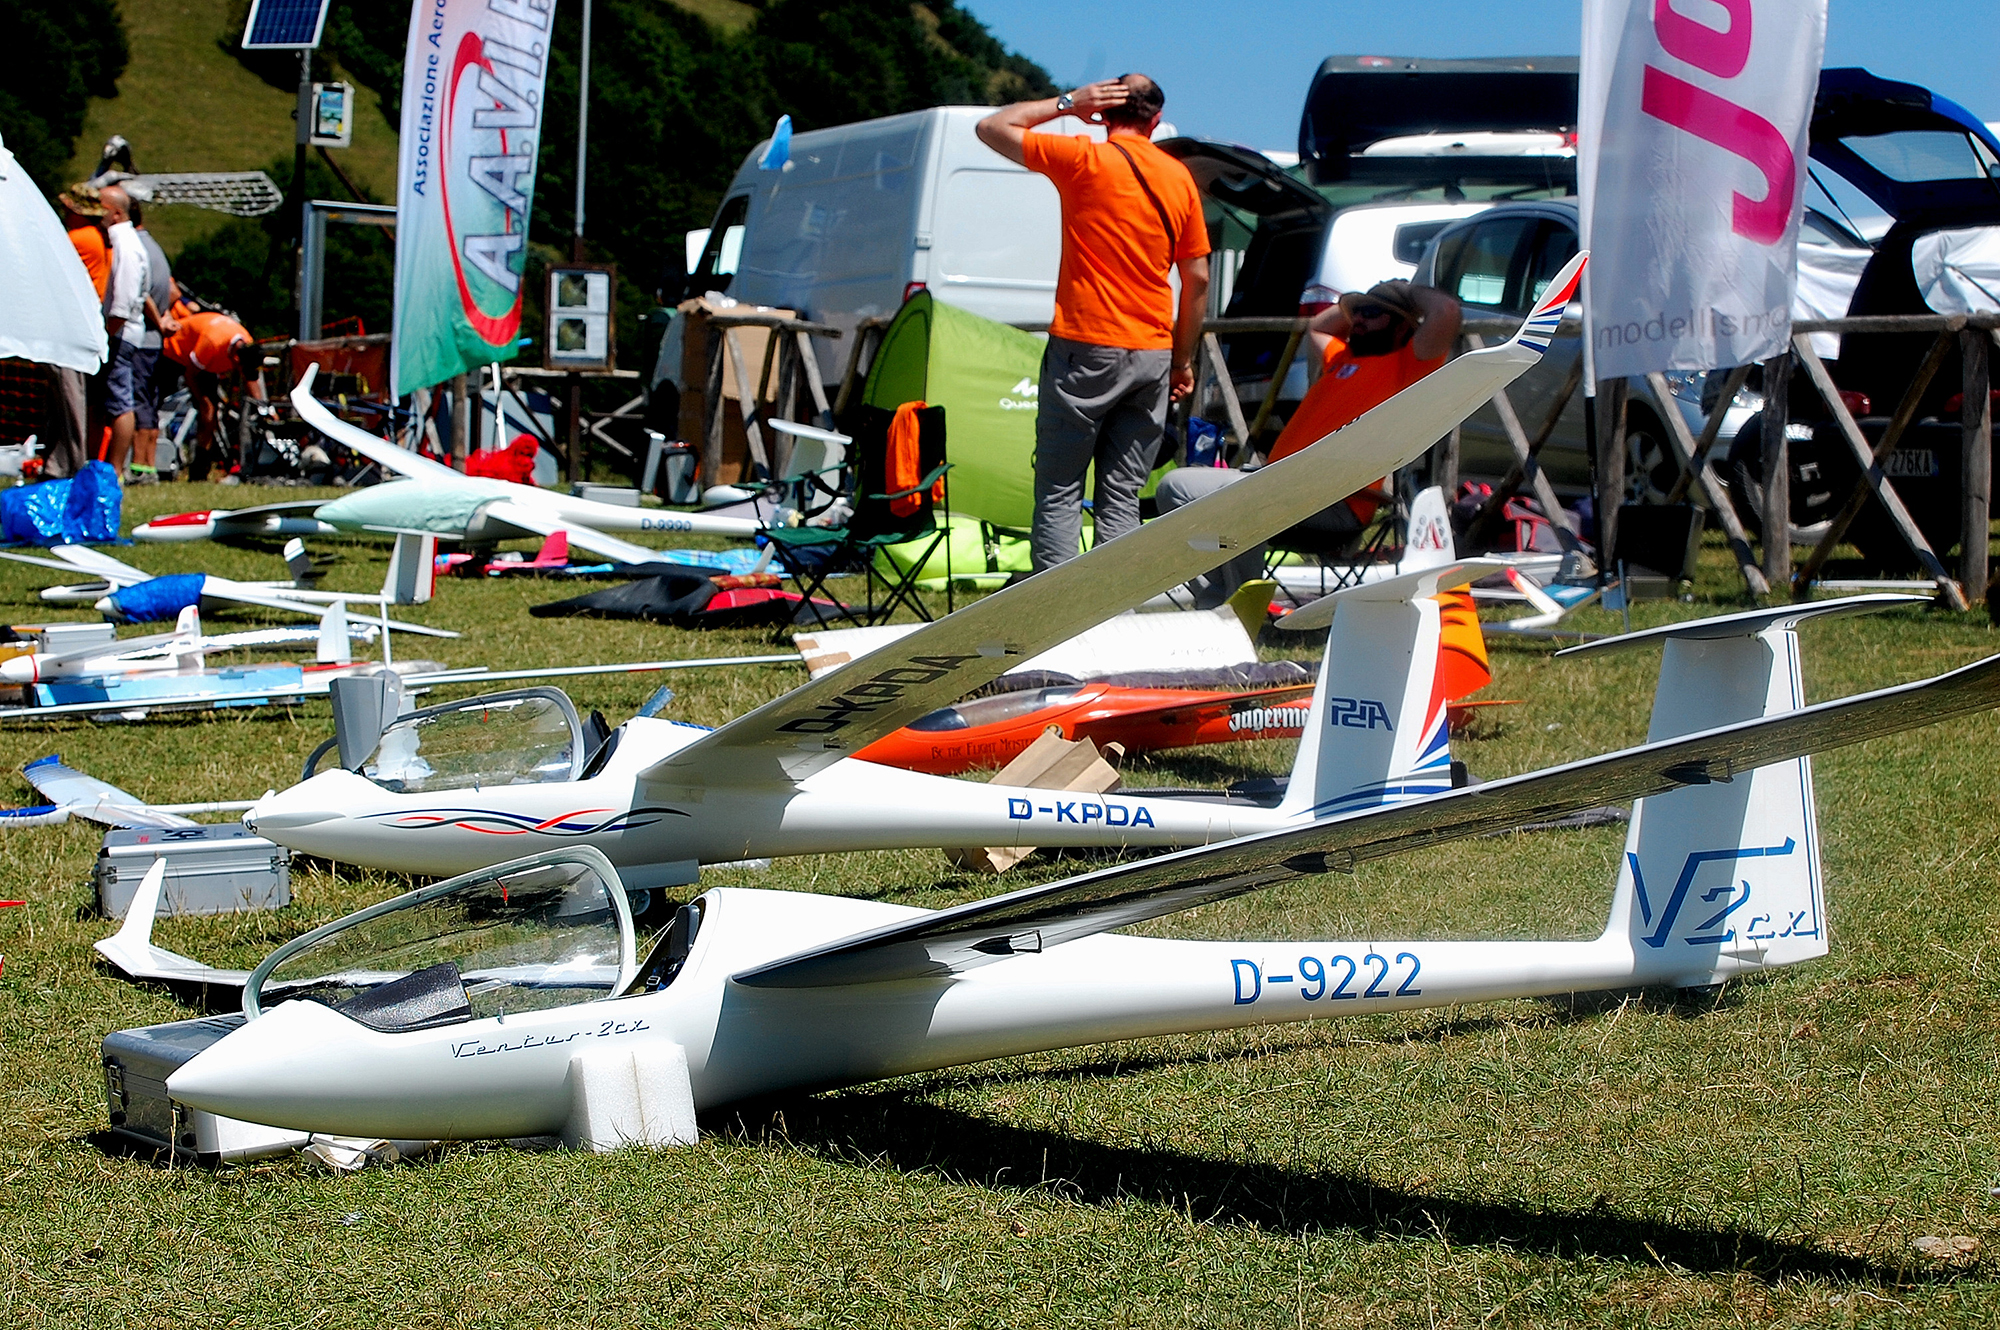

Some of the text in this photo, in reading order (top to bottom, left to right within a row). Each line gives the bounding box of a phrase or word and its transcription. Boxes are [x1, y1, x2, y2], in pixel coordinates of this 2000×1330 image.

[413, 53, 440, 197] Associazione
[1598, 305, 1789, 348] modellismo
[641, 517, 692, 532] D-9990
[775, 654, 983, 733] D-KPDA
[1008, 797, 1155, 828] D-KPDA
[1230, 952, 1422, 1006] D-9222
